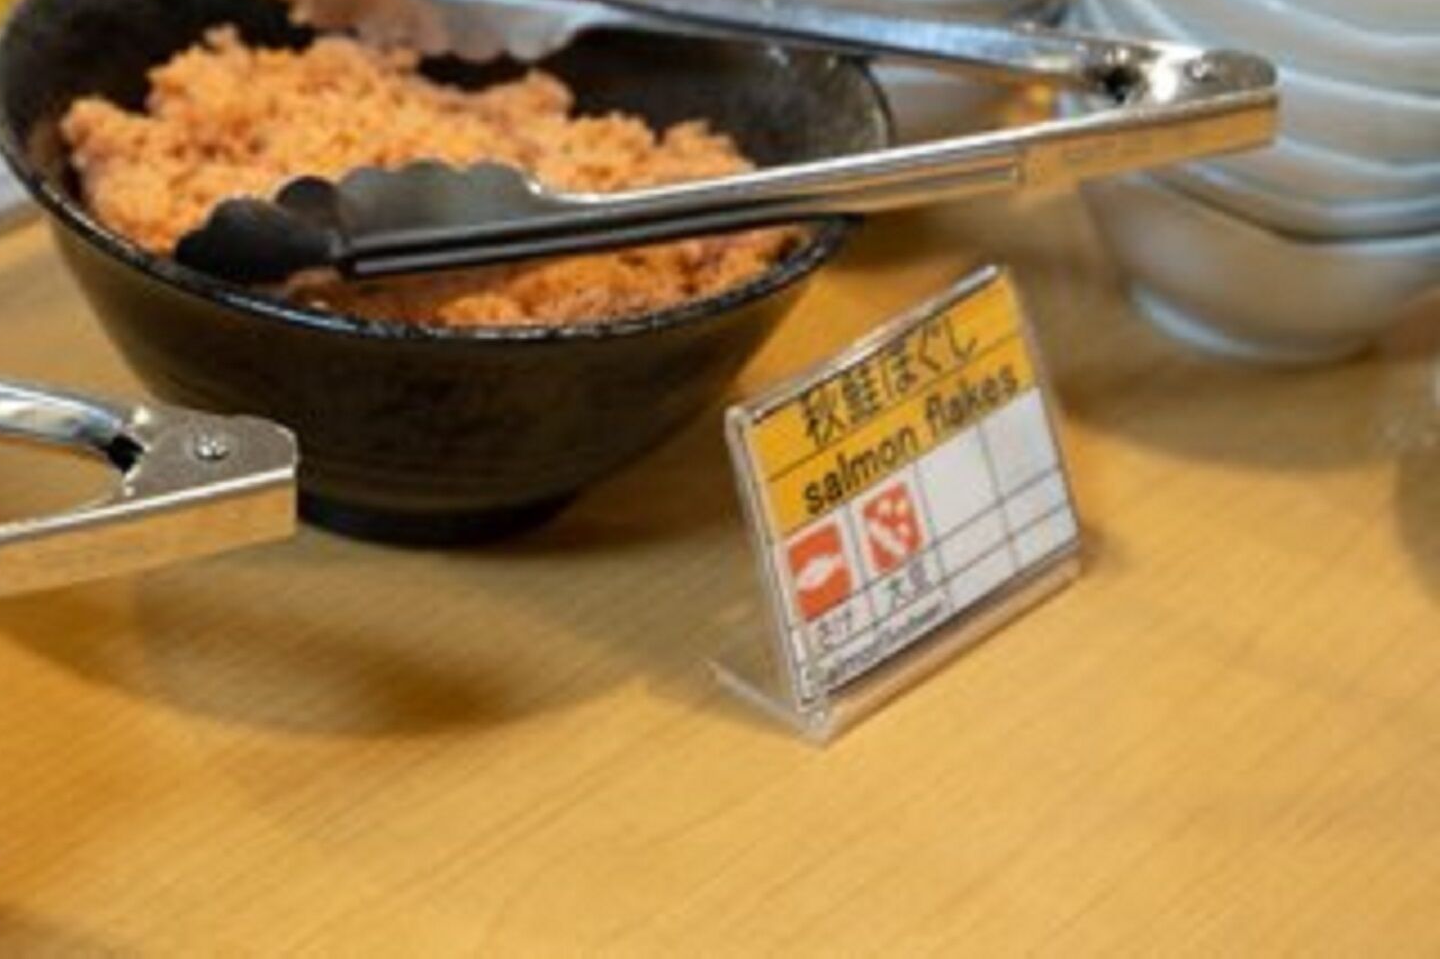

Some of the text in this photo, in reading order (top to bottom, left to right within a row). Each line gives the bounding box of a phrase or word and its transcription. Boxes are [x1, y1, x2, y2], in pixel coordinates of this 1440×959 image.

[800, 316, 978, 448] 秋鮭ほぐし
[805, 366, 1019, 516] salmon flakes
